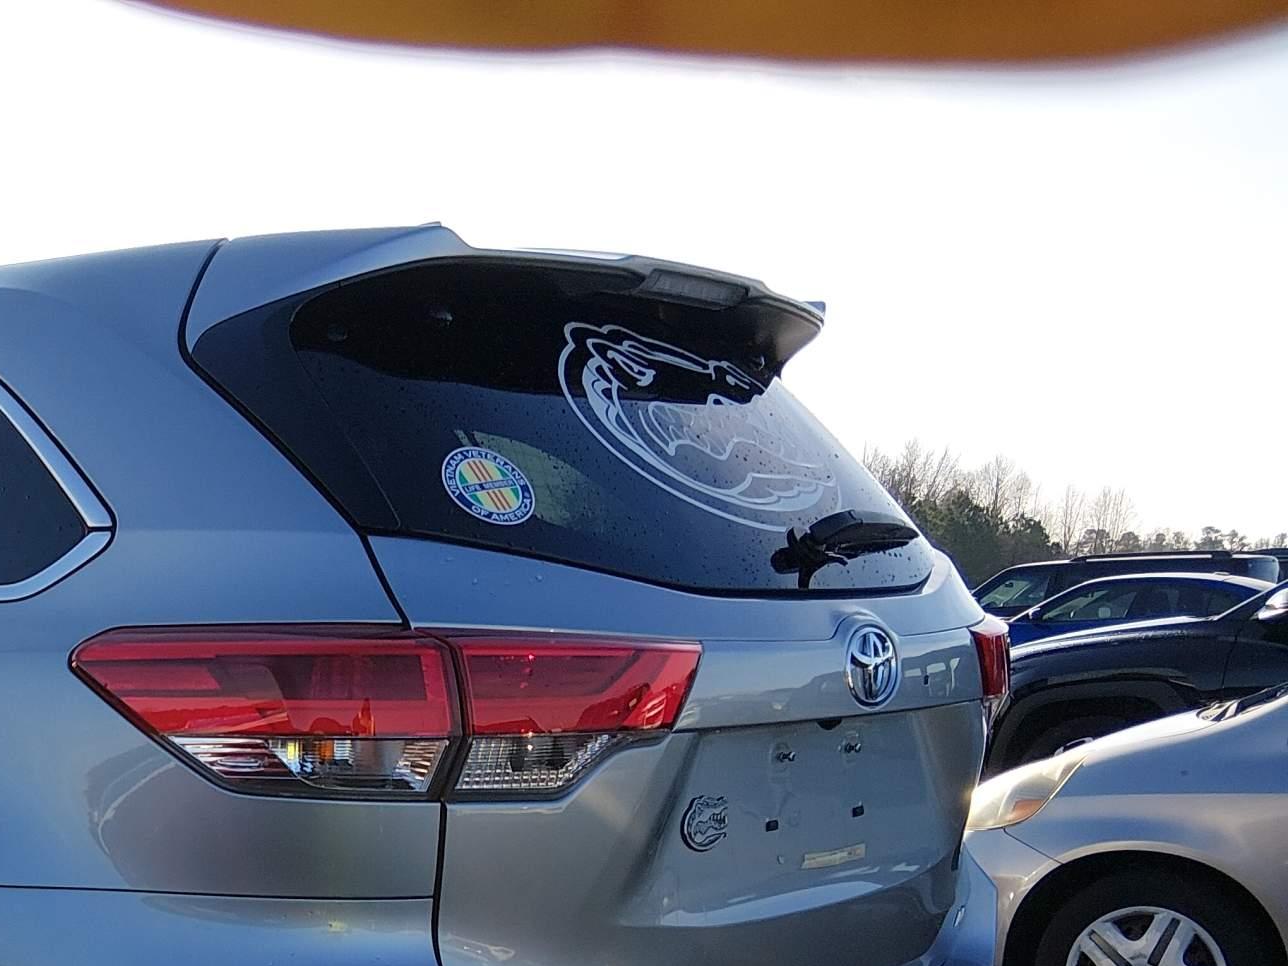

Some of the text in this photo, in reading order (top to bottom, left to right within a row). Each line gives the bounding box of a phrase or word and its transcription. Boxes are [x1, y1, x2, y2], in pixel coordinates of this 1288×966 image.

[445, 450, 526, 497] VIETNAM VETERANS
[464, 479, 515, 493] LIFE MEMBER
[471, 498, 531, 522] OF AMERICA
